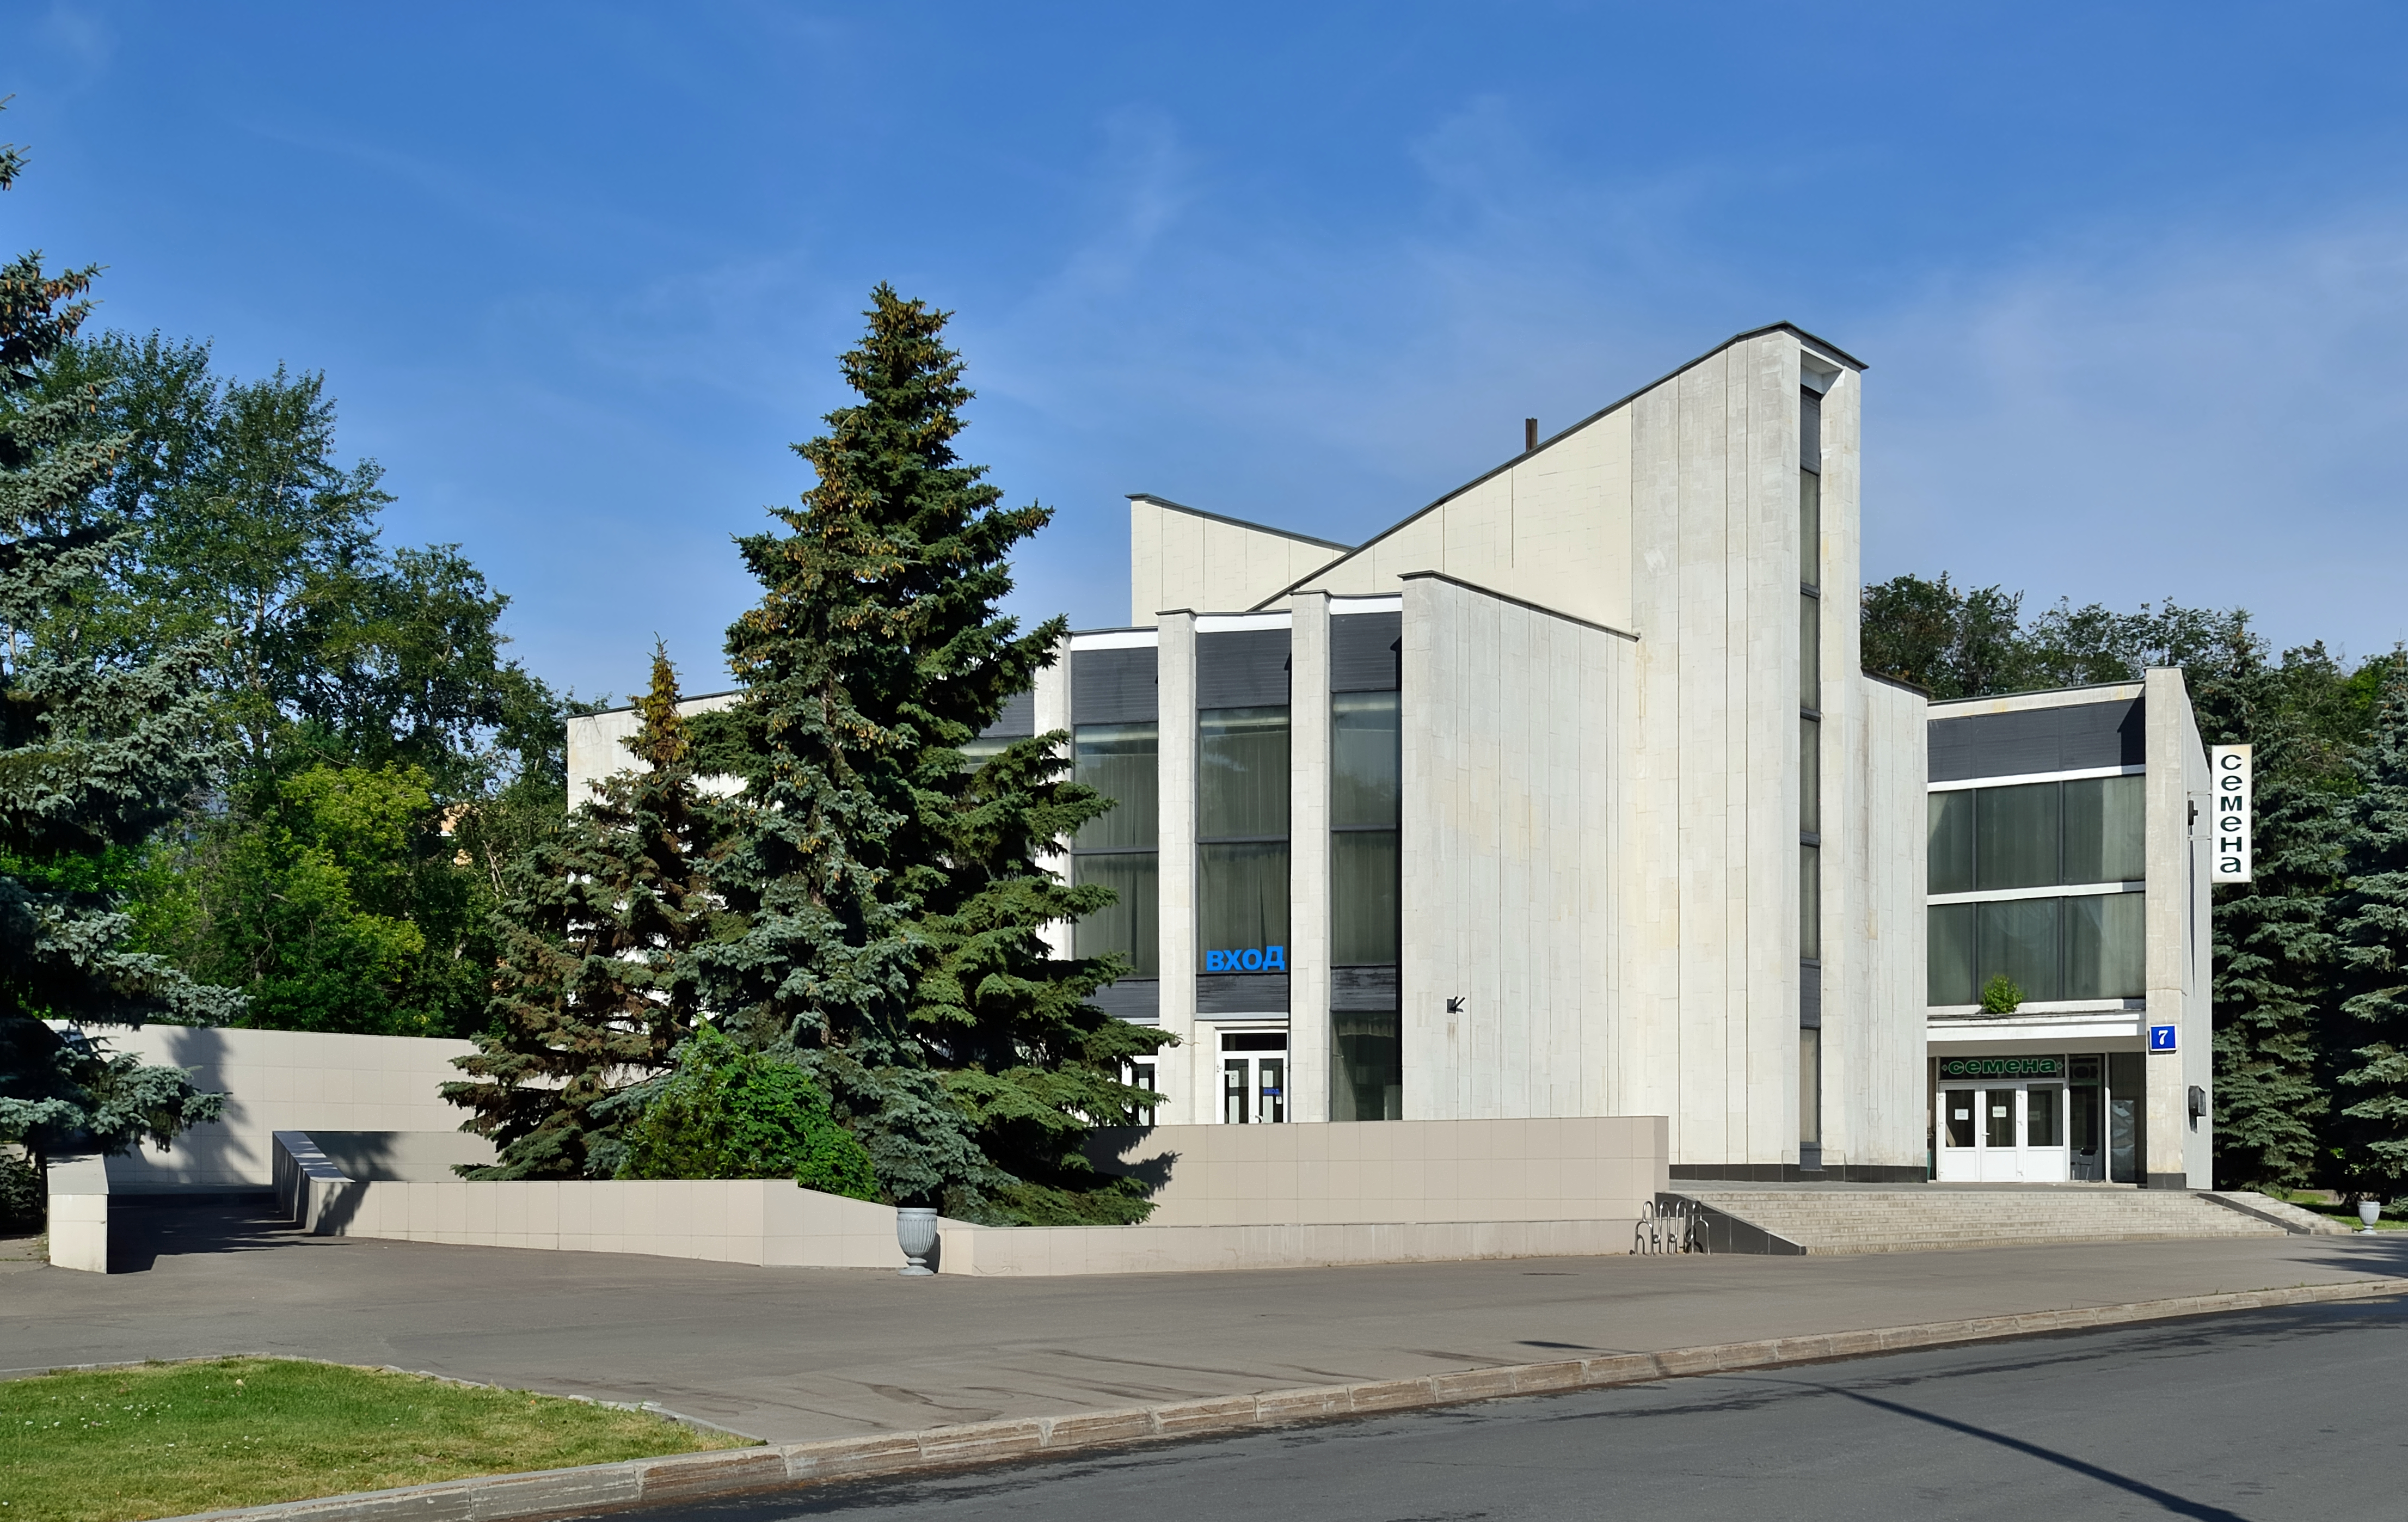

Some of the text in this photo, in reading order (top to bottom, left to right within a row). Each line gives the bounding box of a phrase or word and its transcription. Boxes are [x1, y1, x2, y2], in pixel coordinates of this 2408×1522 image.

[2220, 754, 2243, 873] семена
[1206, 946, 1285, 971] ВХОД
[2158, 1029, 2169, 1045] 7
[1948, 1058, 2057, 1075] семена
